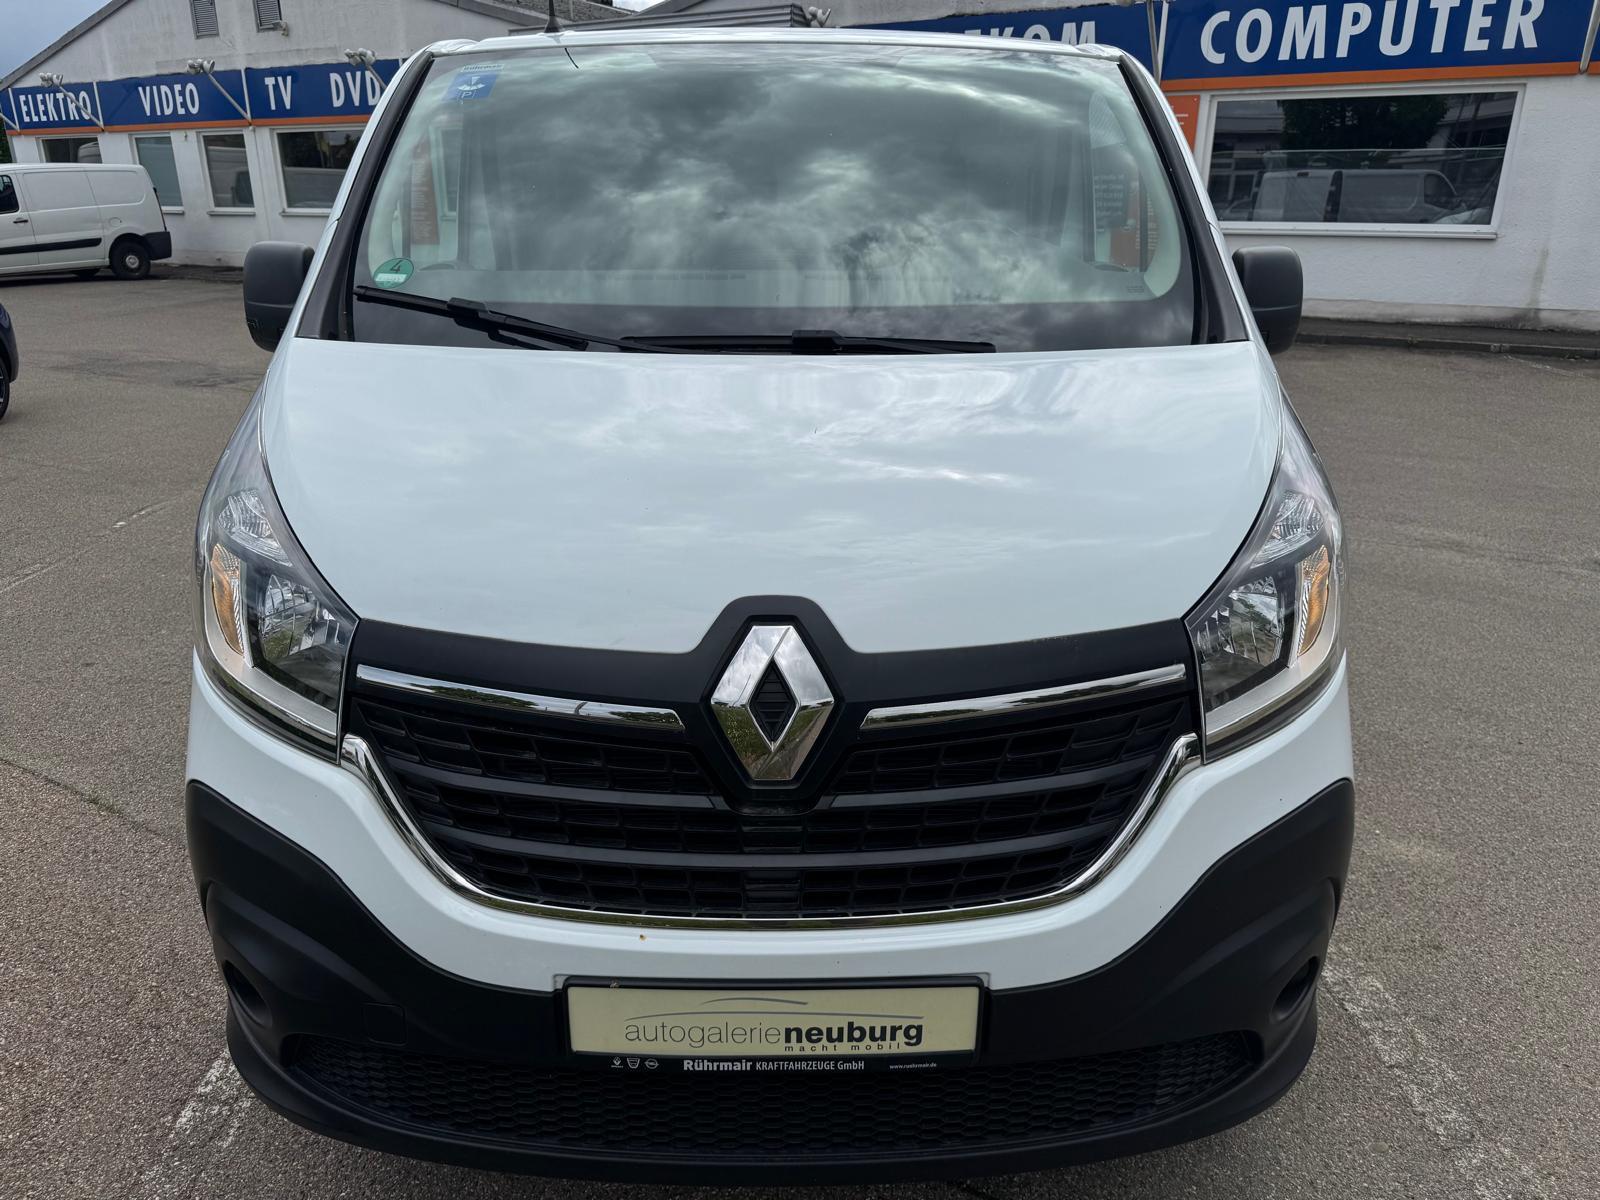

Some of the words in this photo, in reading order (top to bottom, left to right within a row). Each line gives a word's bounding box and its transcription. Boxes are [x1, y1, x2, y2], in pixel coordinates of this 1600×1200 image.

[1201, 0, 1544, 64] COMPUTER
[19, 90, 92, 122] ELEKTRO
[137, 82, 200, 117] VIDEO
[264, 75, 292, 111] TV
[329, 71, 380, 108] DVD
[390, 259, 403, 273] 4
[784, 1044, 839, 1052] macht
[850, 1042, 902, 1051] mobil
[683, 1059, 752, 1071] Rührmair
[755, 1060, 836, 1071] KRAFTFAHRZEUGE
[837, 1060, 865, 1071] GmbH
